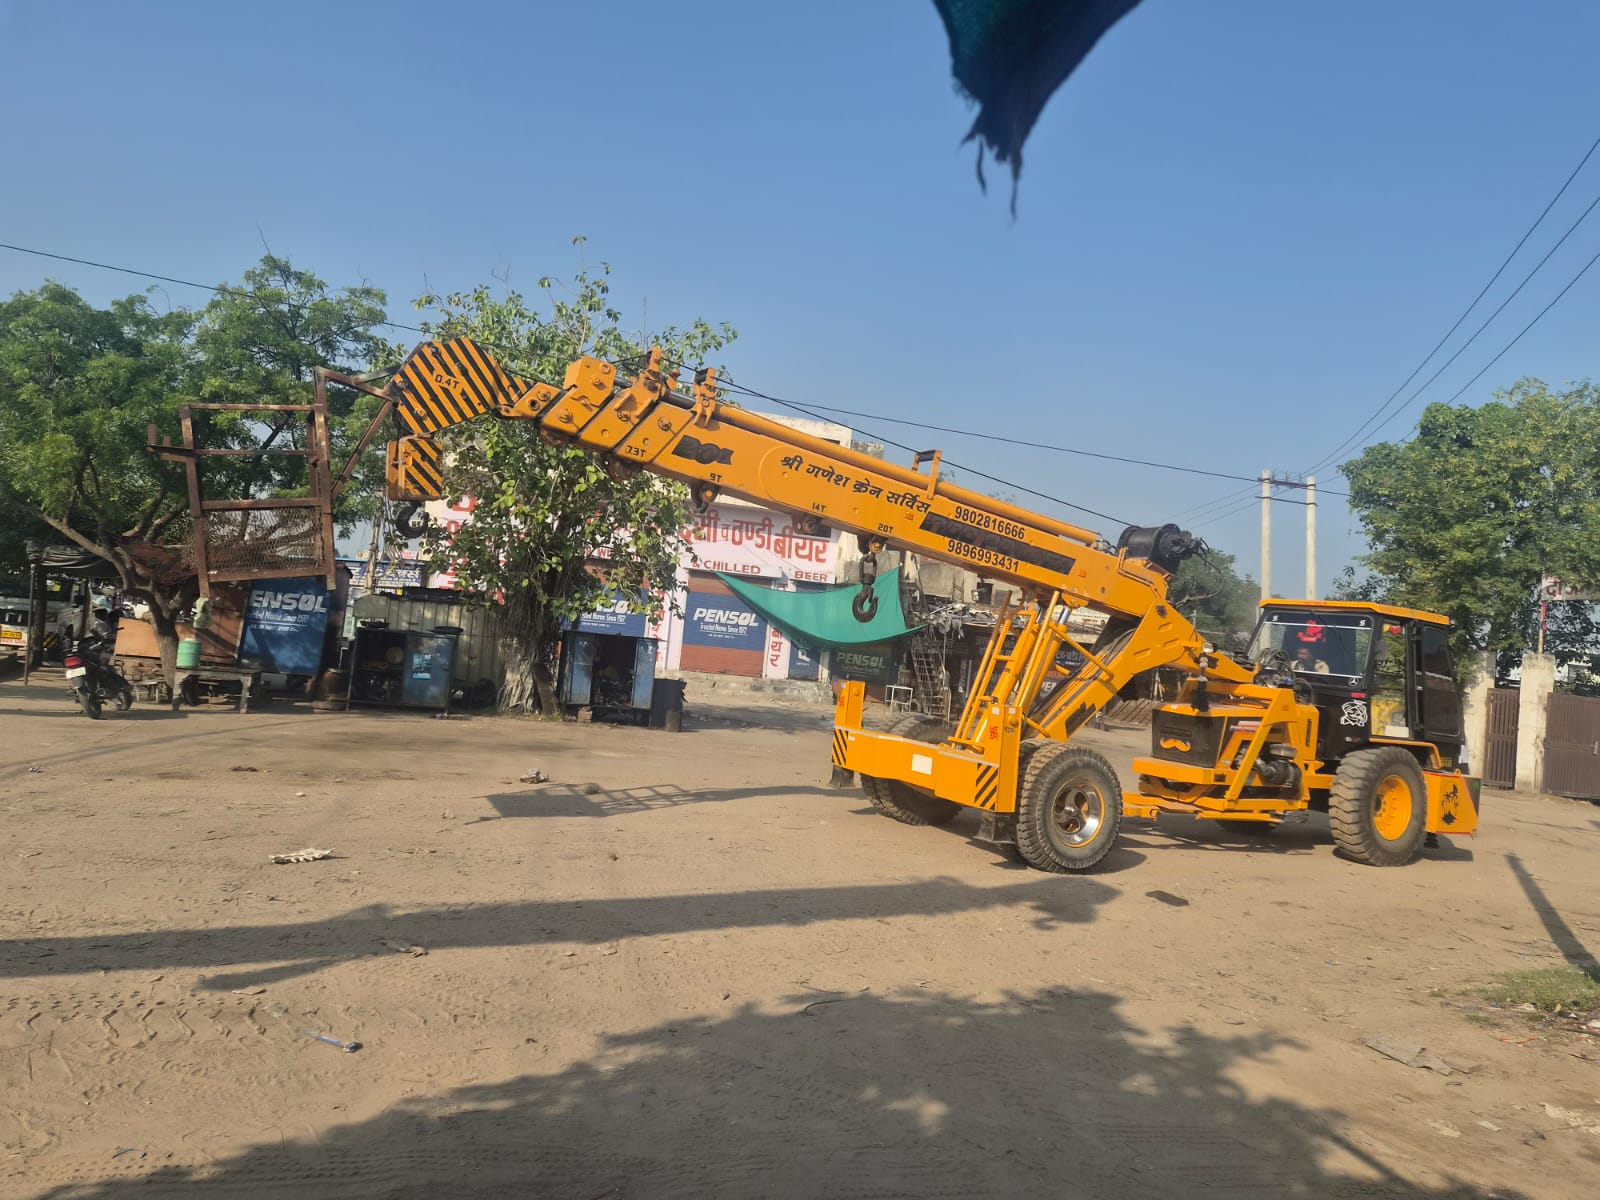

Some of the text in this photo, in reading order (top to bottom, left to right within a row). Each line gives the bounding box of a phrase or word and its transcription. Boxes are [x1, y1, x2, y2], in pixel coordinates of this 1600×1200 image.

[435, 374, 460, 389] 0.4T
[710, 472, 722, 483] 9T
[780, 455, 931, 514] श्री गणेश क्रेन सर्विस
[878, 523, 894, 534] 20T
[954, 506, 1026, 540] 9802816666
[947, 540, 1020, 573] 9896993431
[704, 560, 761, 575] CHILLED
[794, 570, 829, 582] BEER
[249, 590, 327, 613] ENSOL
[693, 607, 759, 627] PENSOL
[836, 651, 886, 669] PENSOL
